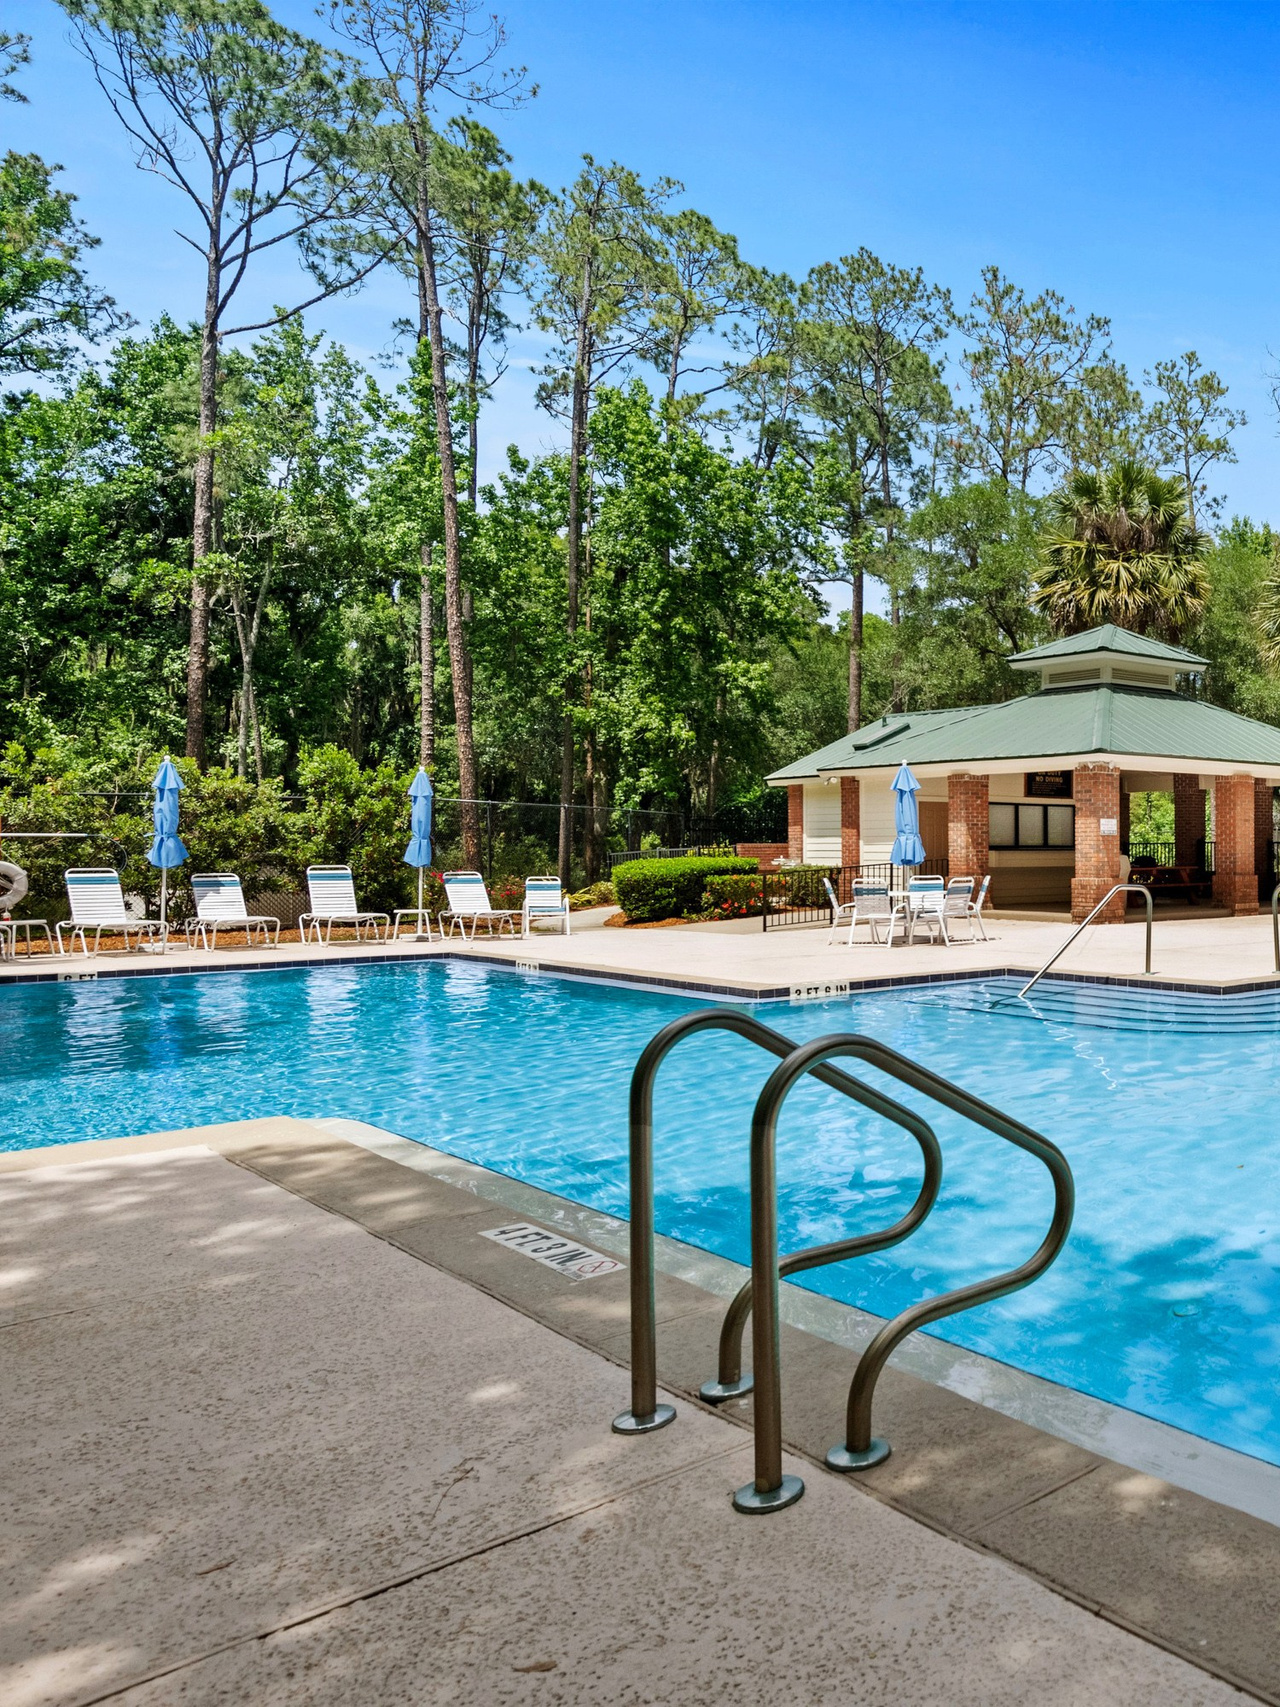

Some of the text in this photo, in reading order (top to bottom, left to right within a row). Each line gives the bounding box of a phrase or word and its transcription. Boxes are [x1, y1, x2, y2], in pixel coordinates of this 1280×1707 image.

[806, 986, 820, 995] FT
[835, 984, 847, 993] IN
[494, 1226, 529, 1237] 4
[531, 1242, 568, 1254] 3
